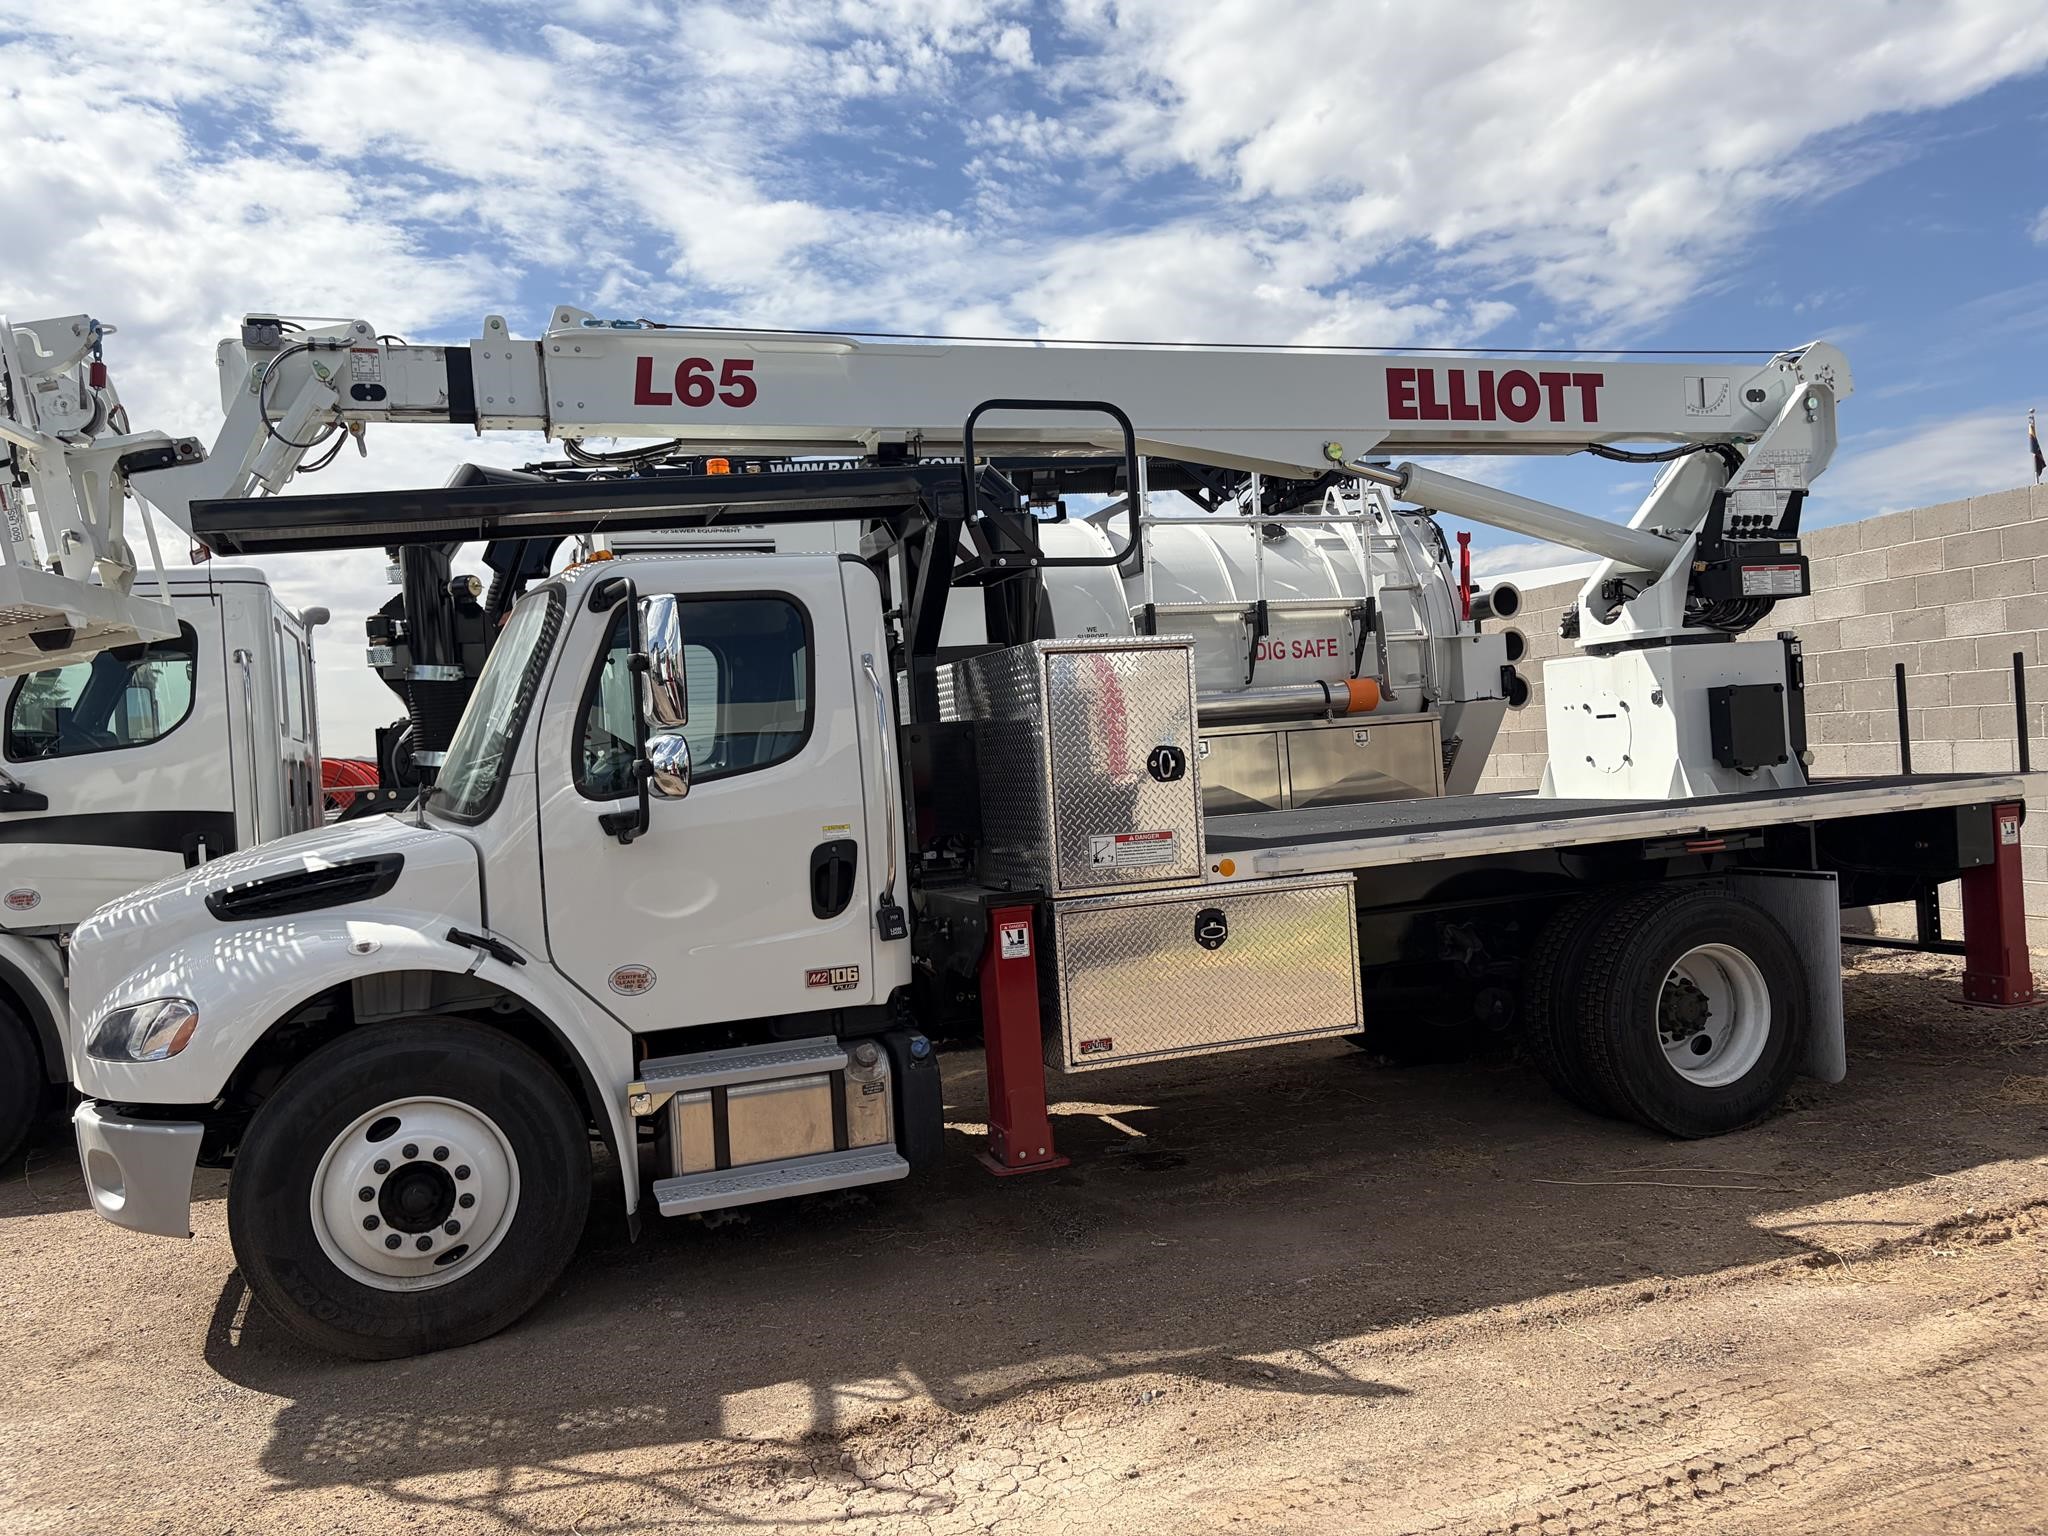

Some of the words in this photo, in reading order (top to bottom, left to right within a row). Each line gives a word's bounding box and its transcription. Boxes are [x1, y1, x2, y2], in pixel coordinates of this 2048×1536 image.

[634, 356, 757, 408] L65
[1386, 367, 1604, 423] ELLIOTT
[1255, 640, 1286, 661] DIG
[1291, 638, 1338, 659] SAFE
[1134, 833, 1160, 841] DANGER
[809, 971, 828, 984] M2
[830, 966, 859, 984] 106
